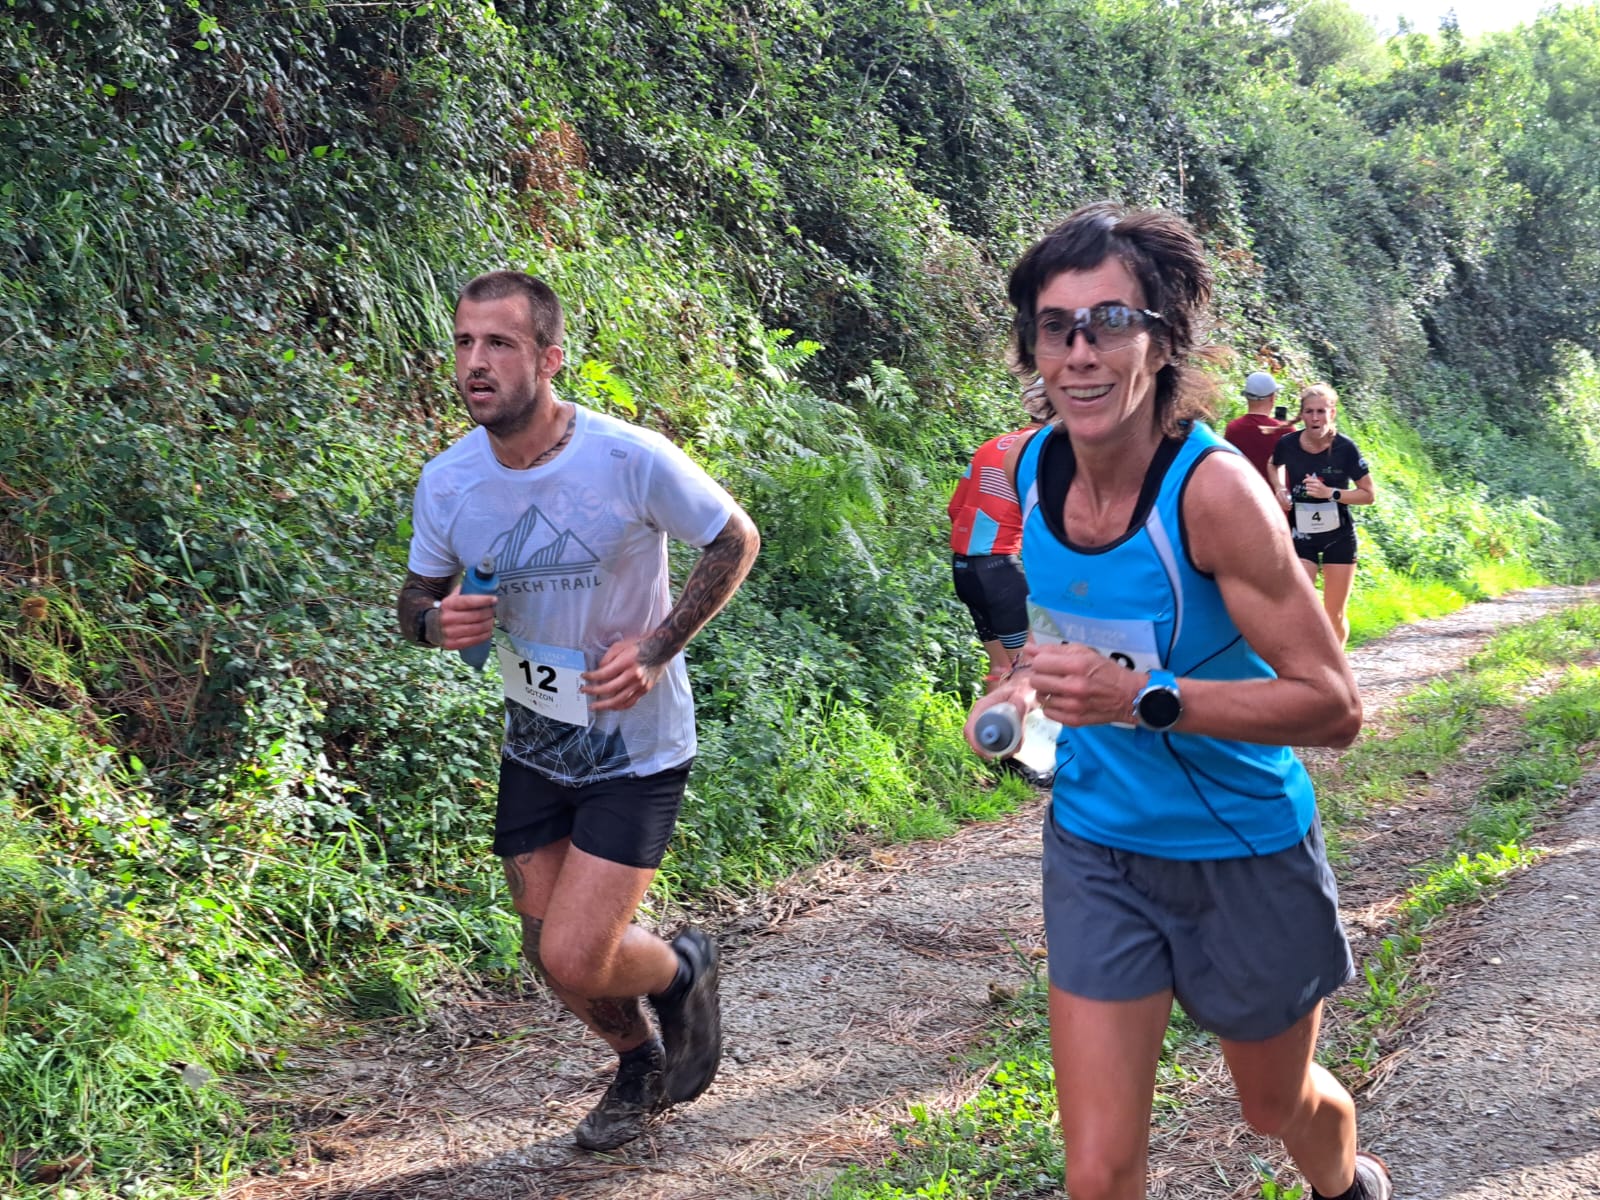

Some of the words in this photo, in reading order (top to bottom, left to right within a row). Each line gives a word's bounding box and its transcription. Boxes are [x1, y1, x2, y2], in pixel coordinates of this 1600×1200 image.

[1312, 512, 1321, 522] 4
[549, 575, 602, 591] TRAIL
[519, 661, 558, 692] 12
